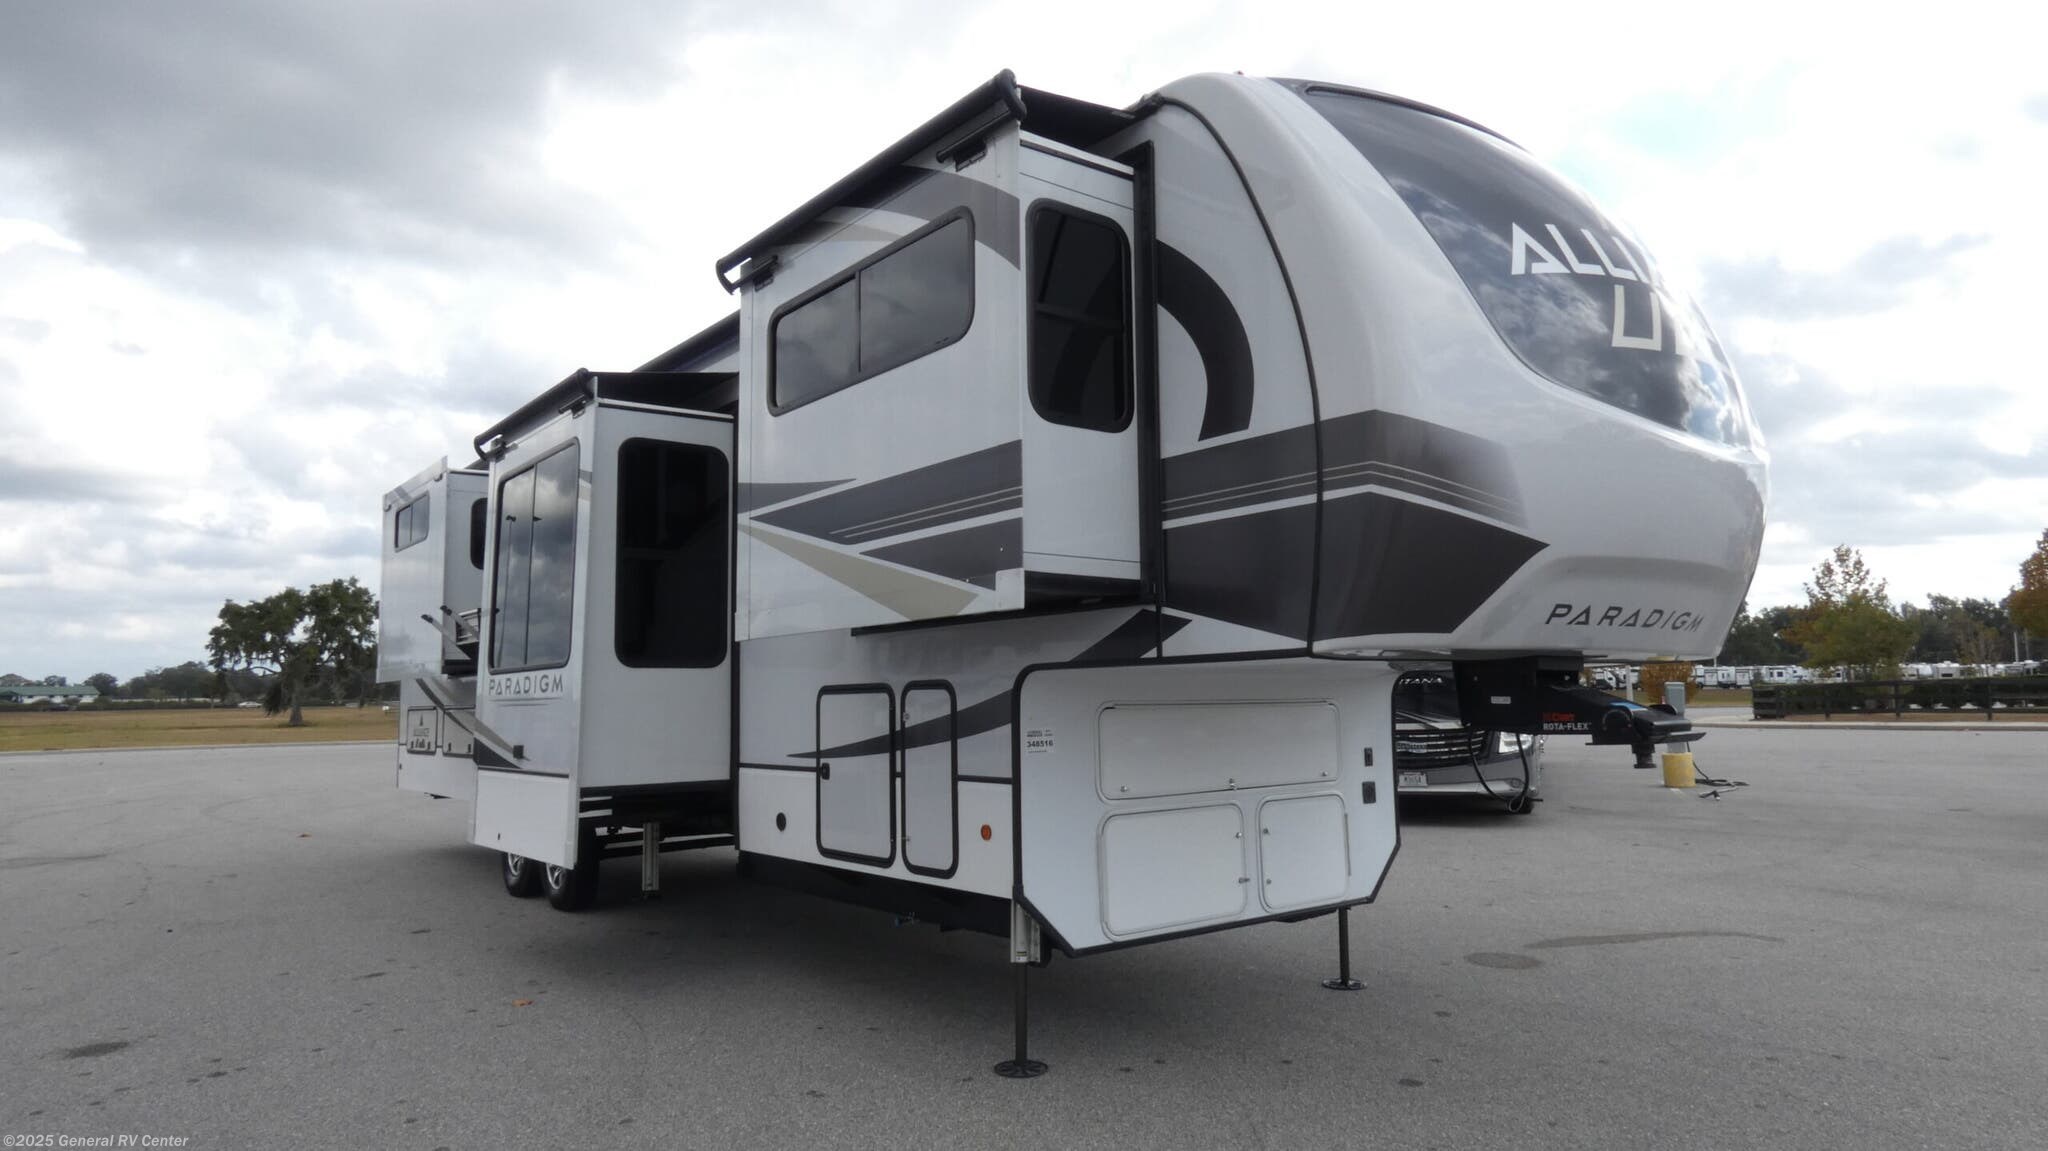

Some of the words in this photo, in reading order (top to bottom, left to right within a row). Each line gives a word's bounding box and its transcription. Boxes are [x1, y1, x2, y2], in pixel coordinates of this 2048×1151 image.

[1511, 222, 1651, 284] ALLI
[1545, 603, 1704, 633] PARADIGM
[489, 674, 563, 696] PARADIGM
